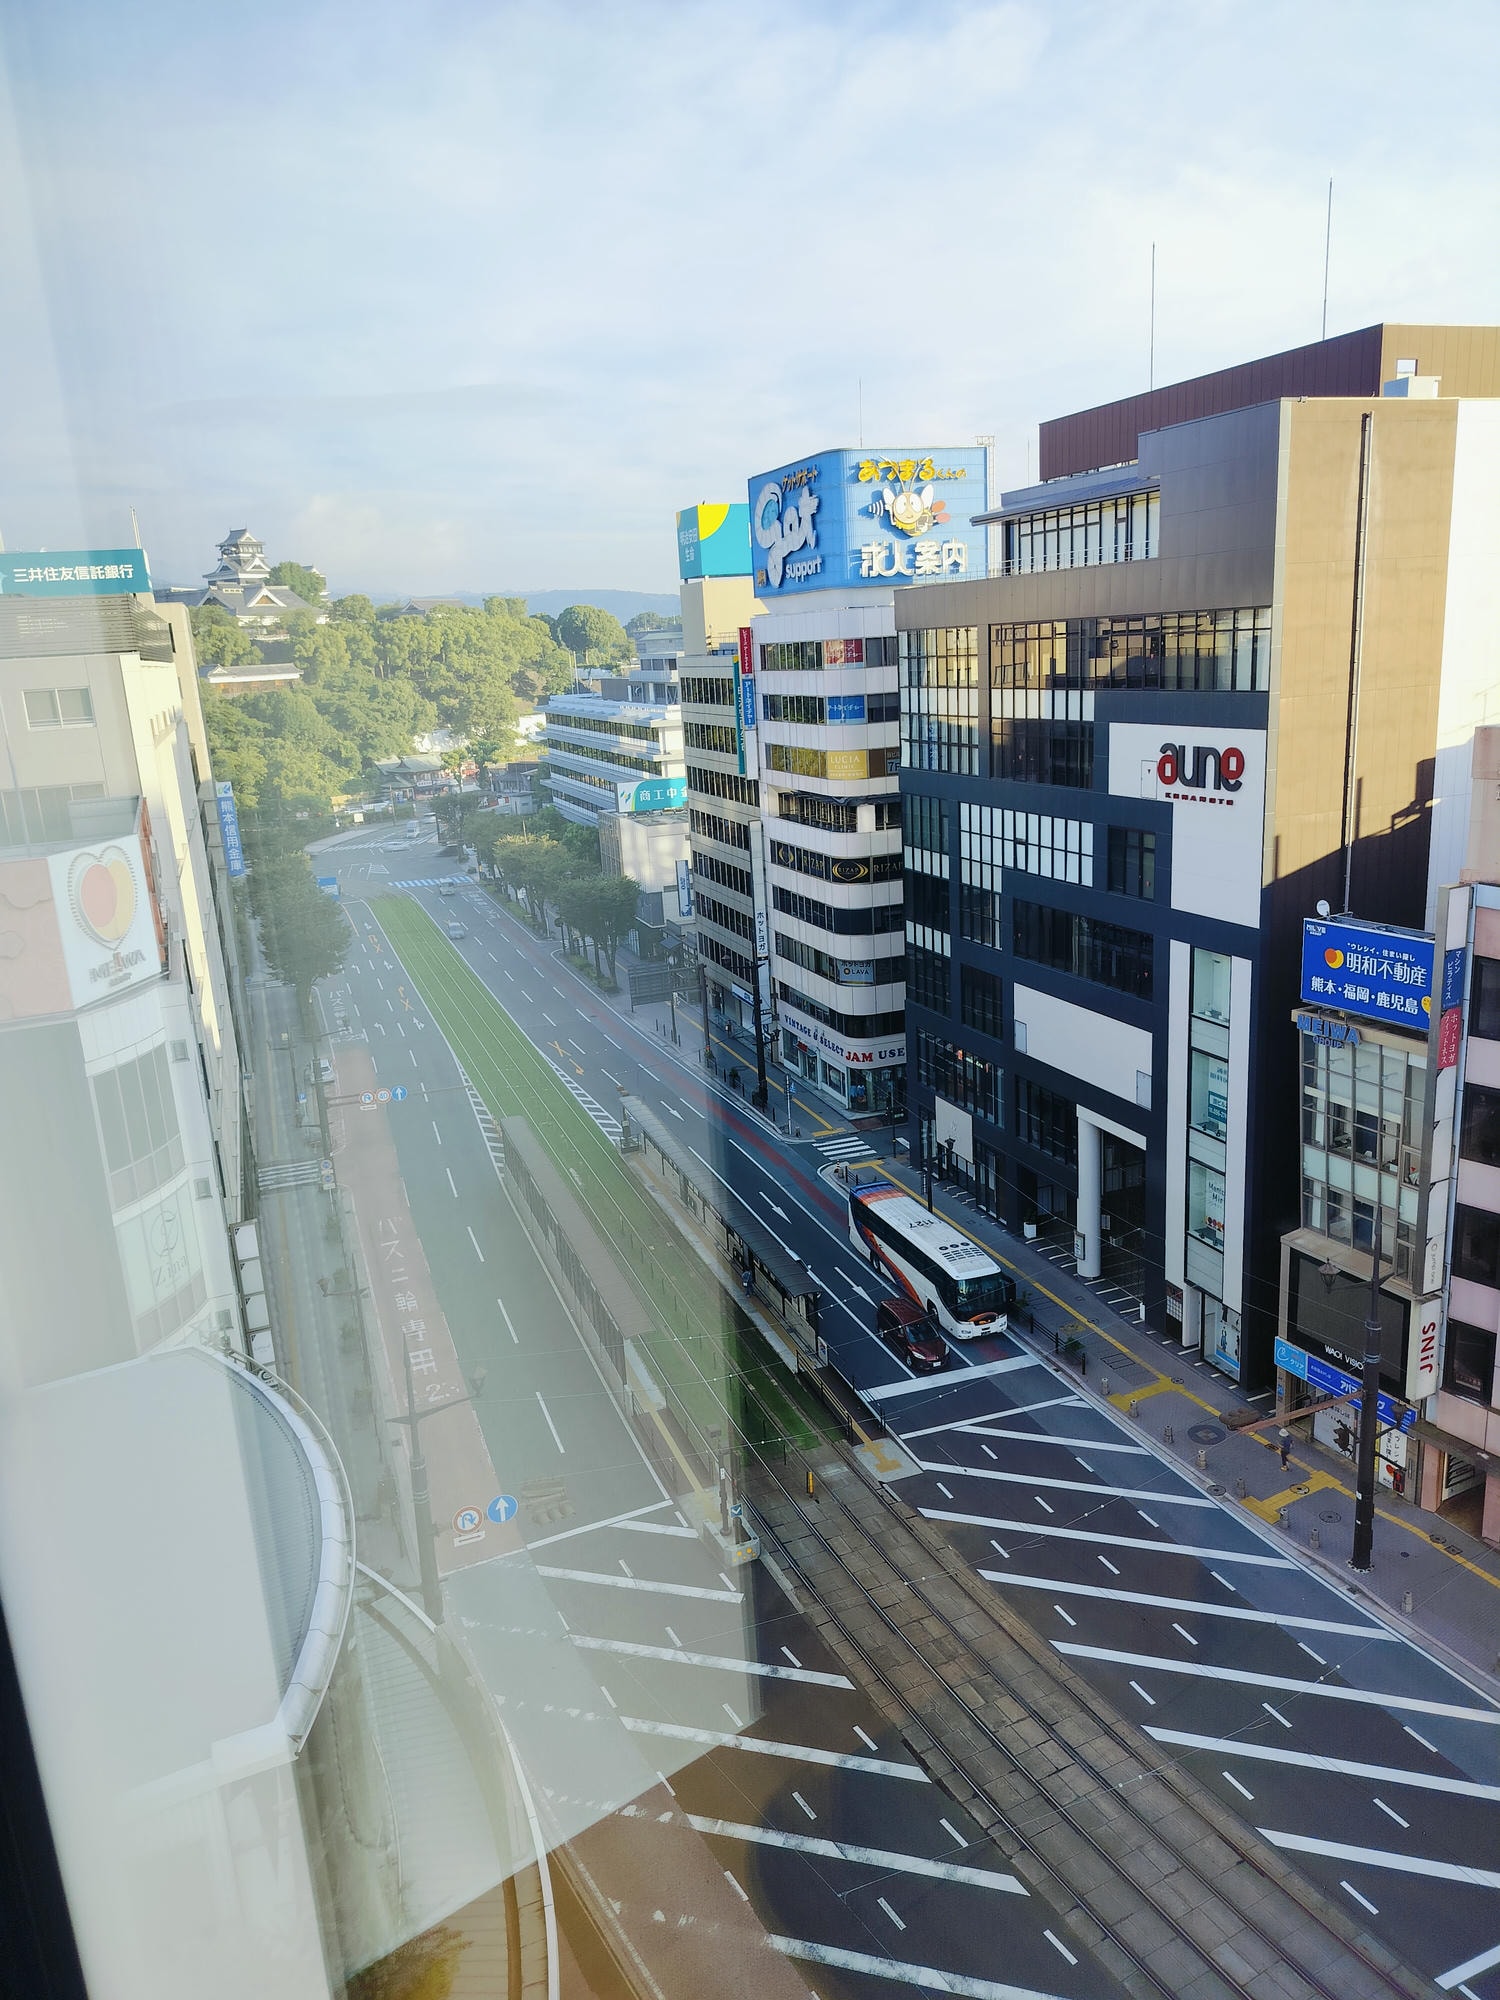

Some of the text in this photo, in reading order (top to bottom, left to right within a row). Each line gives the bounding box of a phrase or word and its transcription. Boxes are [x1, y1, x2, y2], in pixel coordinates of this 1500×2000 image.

[13, 564, 134, 582] 三井住友信託銀行
[785, 556, 822, 583] support
[861, 537, 968, 577] 求人案内
[830, 755, 860, 764] LUCIA
[221, 800, 242, 871] 熊本信用金庫
[757, 912, 766, 951] ホットヨガ
[1346, 952, 1427, 988] 明和不動産
[1311, 976, 1419, 1015] 熊本・福岡・鹿児島
[784, 1014, 812, 1038] VINTAGE
[819, 1035, 845, 1057] SELECT
[1296, 1014, 1359, 1048] MEIWA
[1448, 1013, 1459, 1063] ホットヨガ
[845, 1051, 874, 1063] JAM
[1344, 1354, 1364, 1371] VISIO
